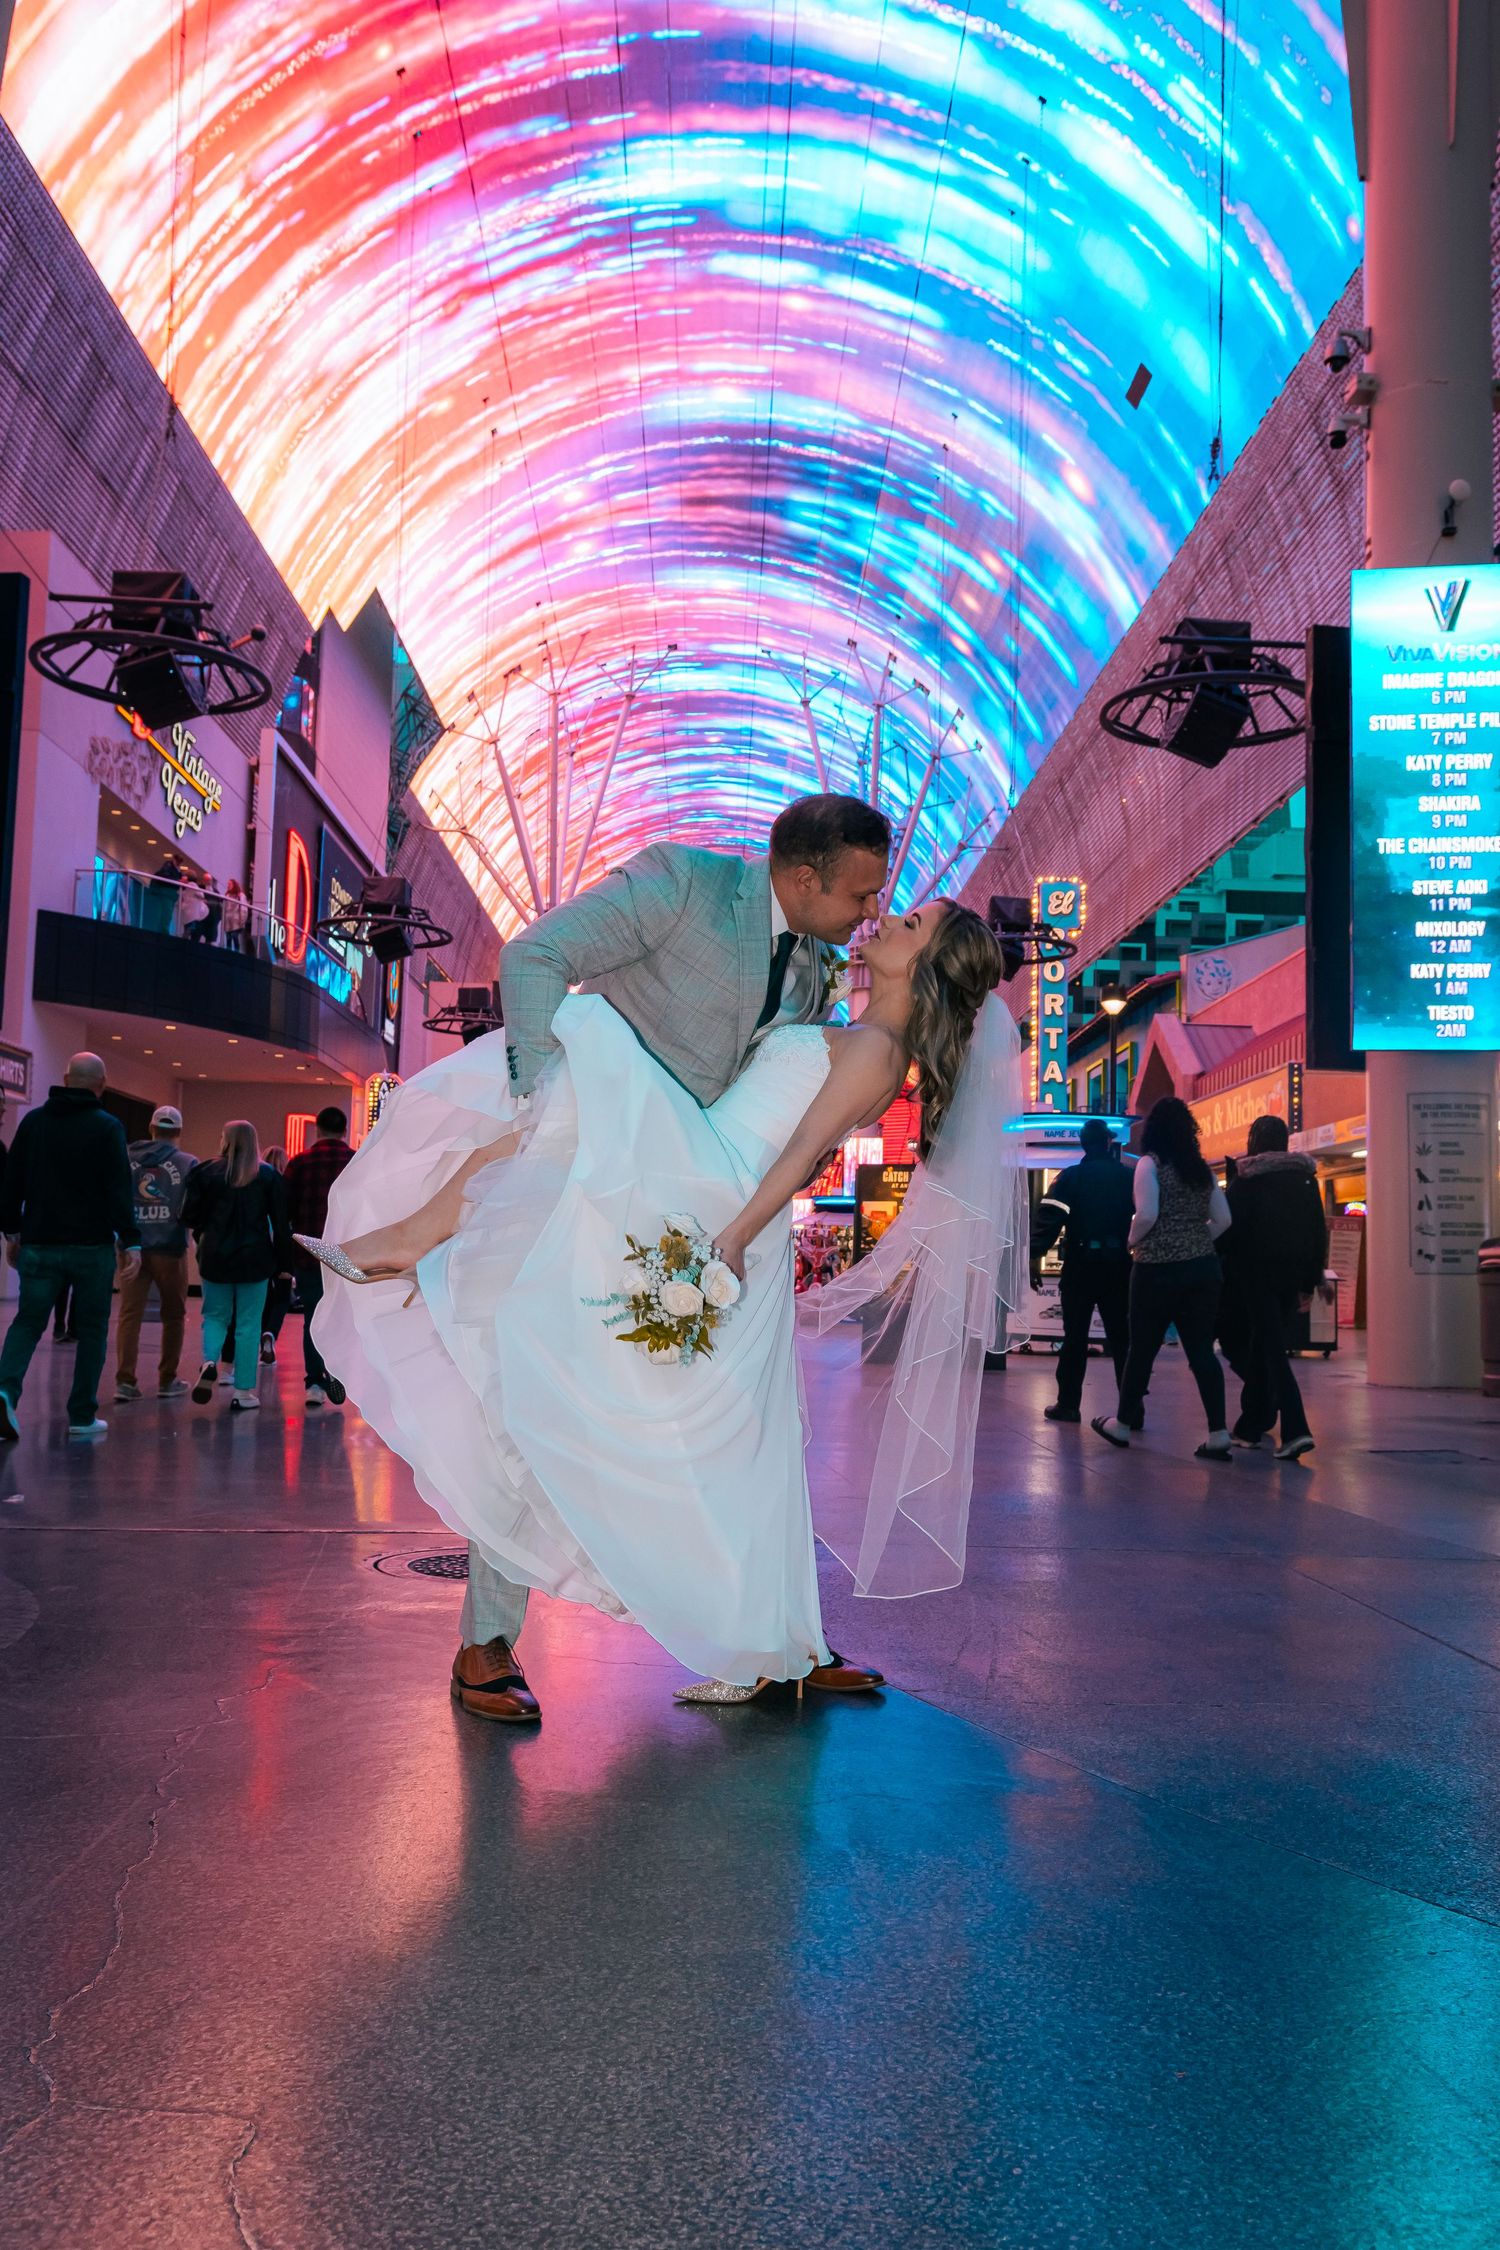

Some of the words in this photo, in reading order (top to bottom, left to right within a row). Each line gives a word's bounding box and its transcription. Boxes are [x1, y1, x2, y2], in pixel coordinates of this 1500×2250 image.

[1382, 672, 1444, 689] IMAGINE
[1432, 691, 1441, 705] 6
[1444, 690, 1467, 704] PM
[1369, 714, 1416, 731] STONE
[1418, 712, 1477, 730] TEMPLE
[1431, 732, 1441, 746] 7
[1444, 731, 1467, 745] PM
[172, 722, 222, 814] Vintage
[1406, 754, 1443, 771] KATY
[1446, 753, 1493, 770] PERRY
[1432, 774, 1441, 788] 8
[1444, 773, 1467, 787] PM
[162, 762, 203, 838] Vegas
[1418, 795, 1481, 812] SHAKIRA
[1432, 814, 1441, 829] 9
[1445, 814, 1467, 827] PM
[1376, 838, 1405, 854] THE
[1429, 856, 1446, 870] 10
[1449, 856, 1472, 869] PM
[1412, 880, 1453, 895] STEVE
[1456, 879, 1488, 894] AOKI
[1048, 890, 1075, 915] El
[1429, 898, 1444, 911] 11
[1449, 898, 1472, 911] PM
[1415, 921, 1486, 937] MIXOLOGY
[1430, 940, 1446, 954] 12
[1449, 940, 1472, 953] AM
[1410, 964, 1444, 979] KATY
[1447, 963, 1492, 978] PERRY
[1434, 982, 1441, 995] 1
[1446, 982, 1468, 994] AM
[1427, 1005, 1474, 1021] TIESTO
[1436, 1024, 1466, 1037] 2AM
[882, 1171, 909, 1182] CATCH
